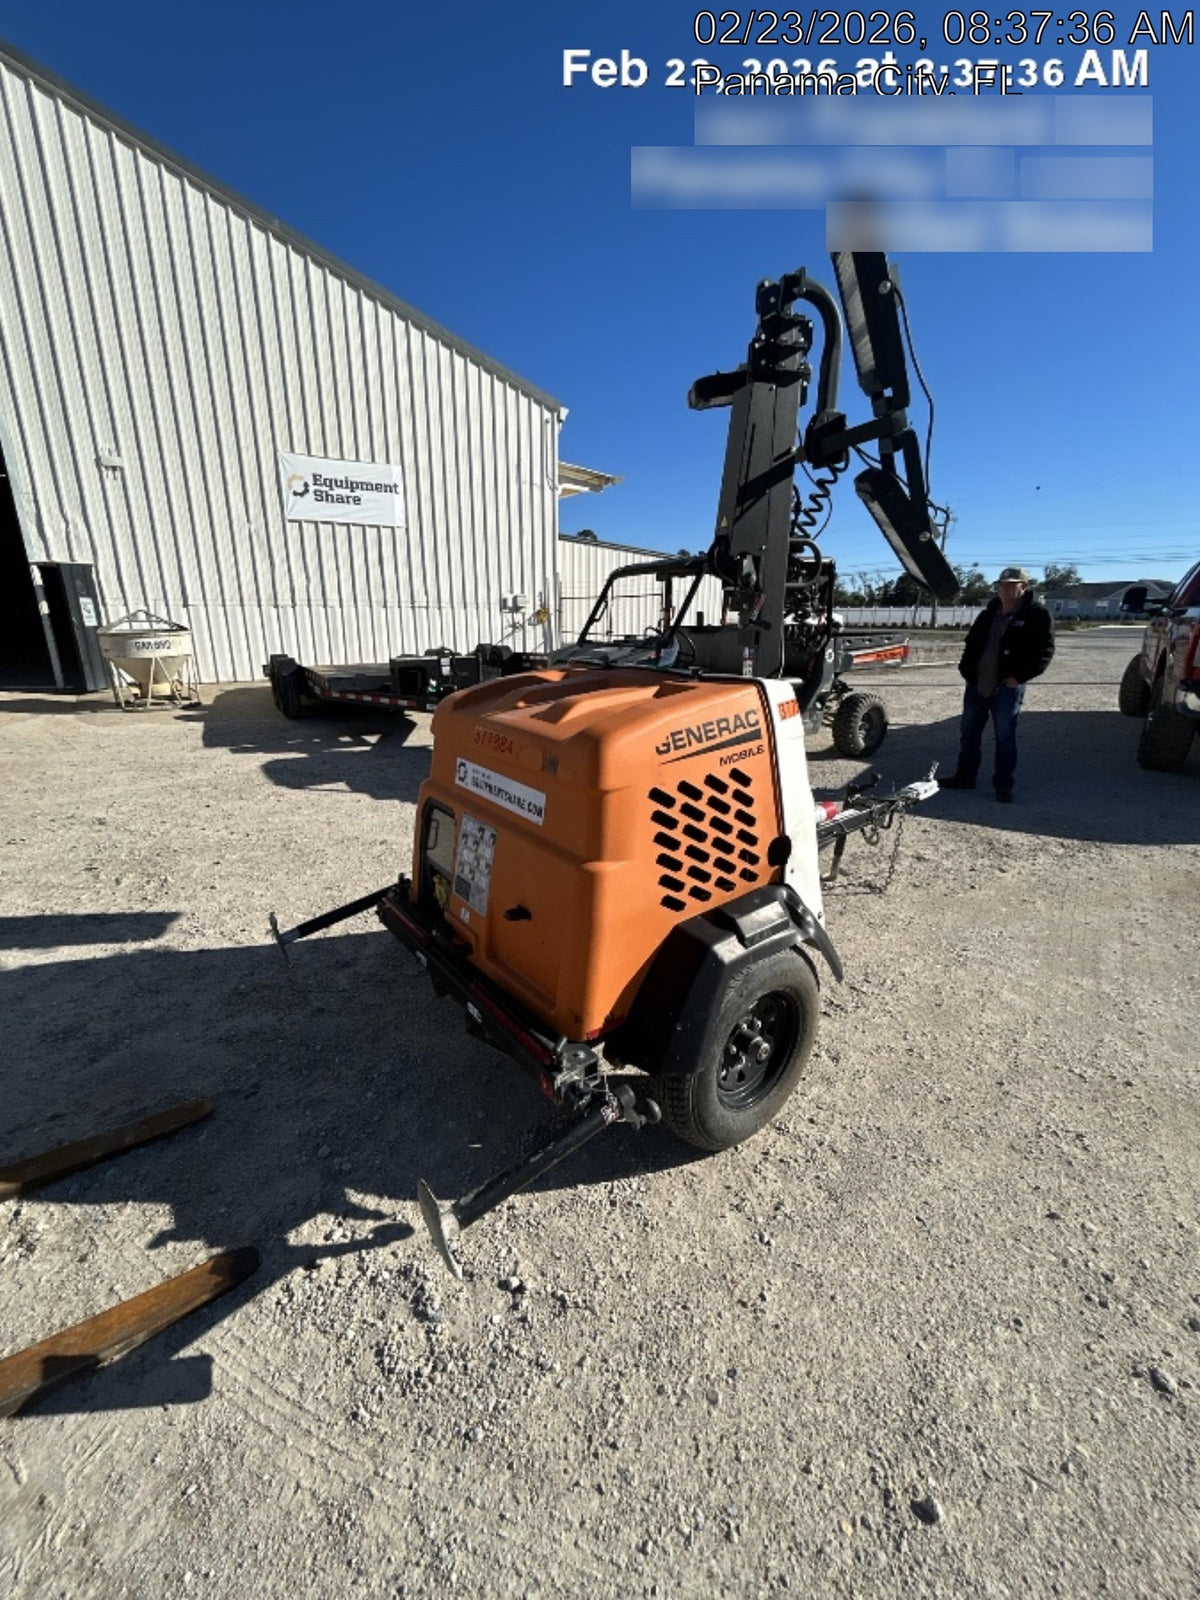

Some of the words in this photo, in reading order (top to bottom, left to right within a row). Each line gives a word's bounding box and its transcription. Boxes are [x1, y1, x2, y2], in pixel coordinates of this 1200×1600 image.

[311, 473, 400, 495] Equipment
[313, 489, 362, 505] Share
[655, 709, 760, 756] GENERAC
[719, 745, 765, 767] MOBILE
